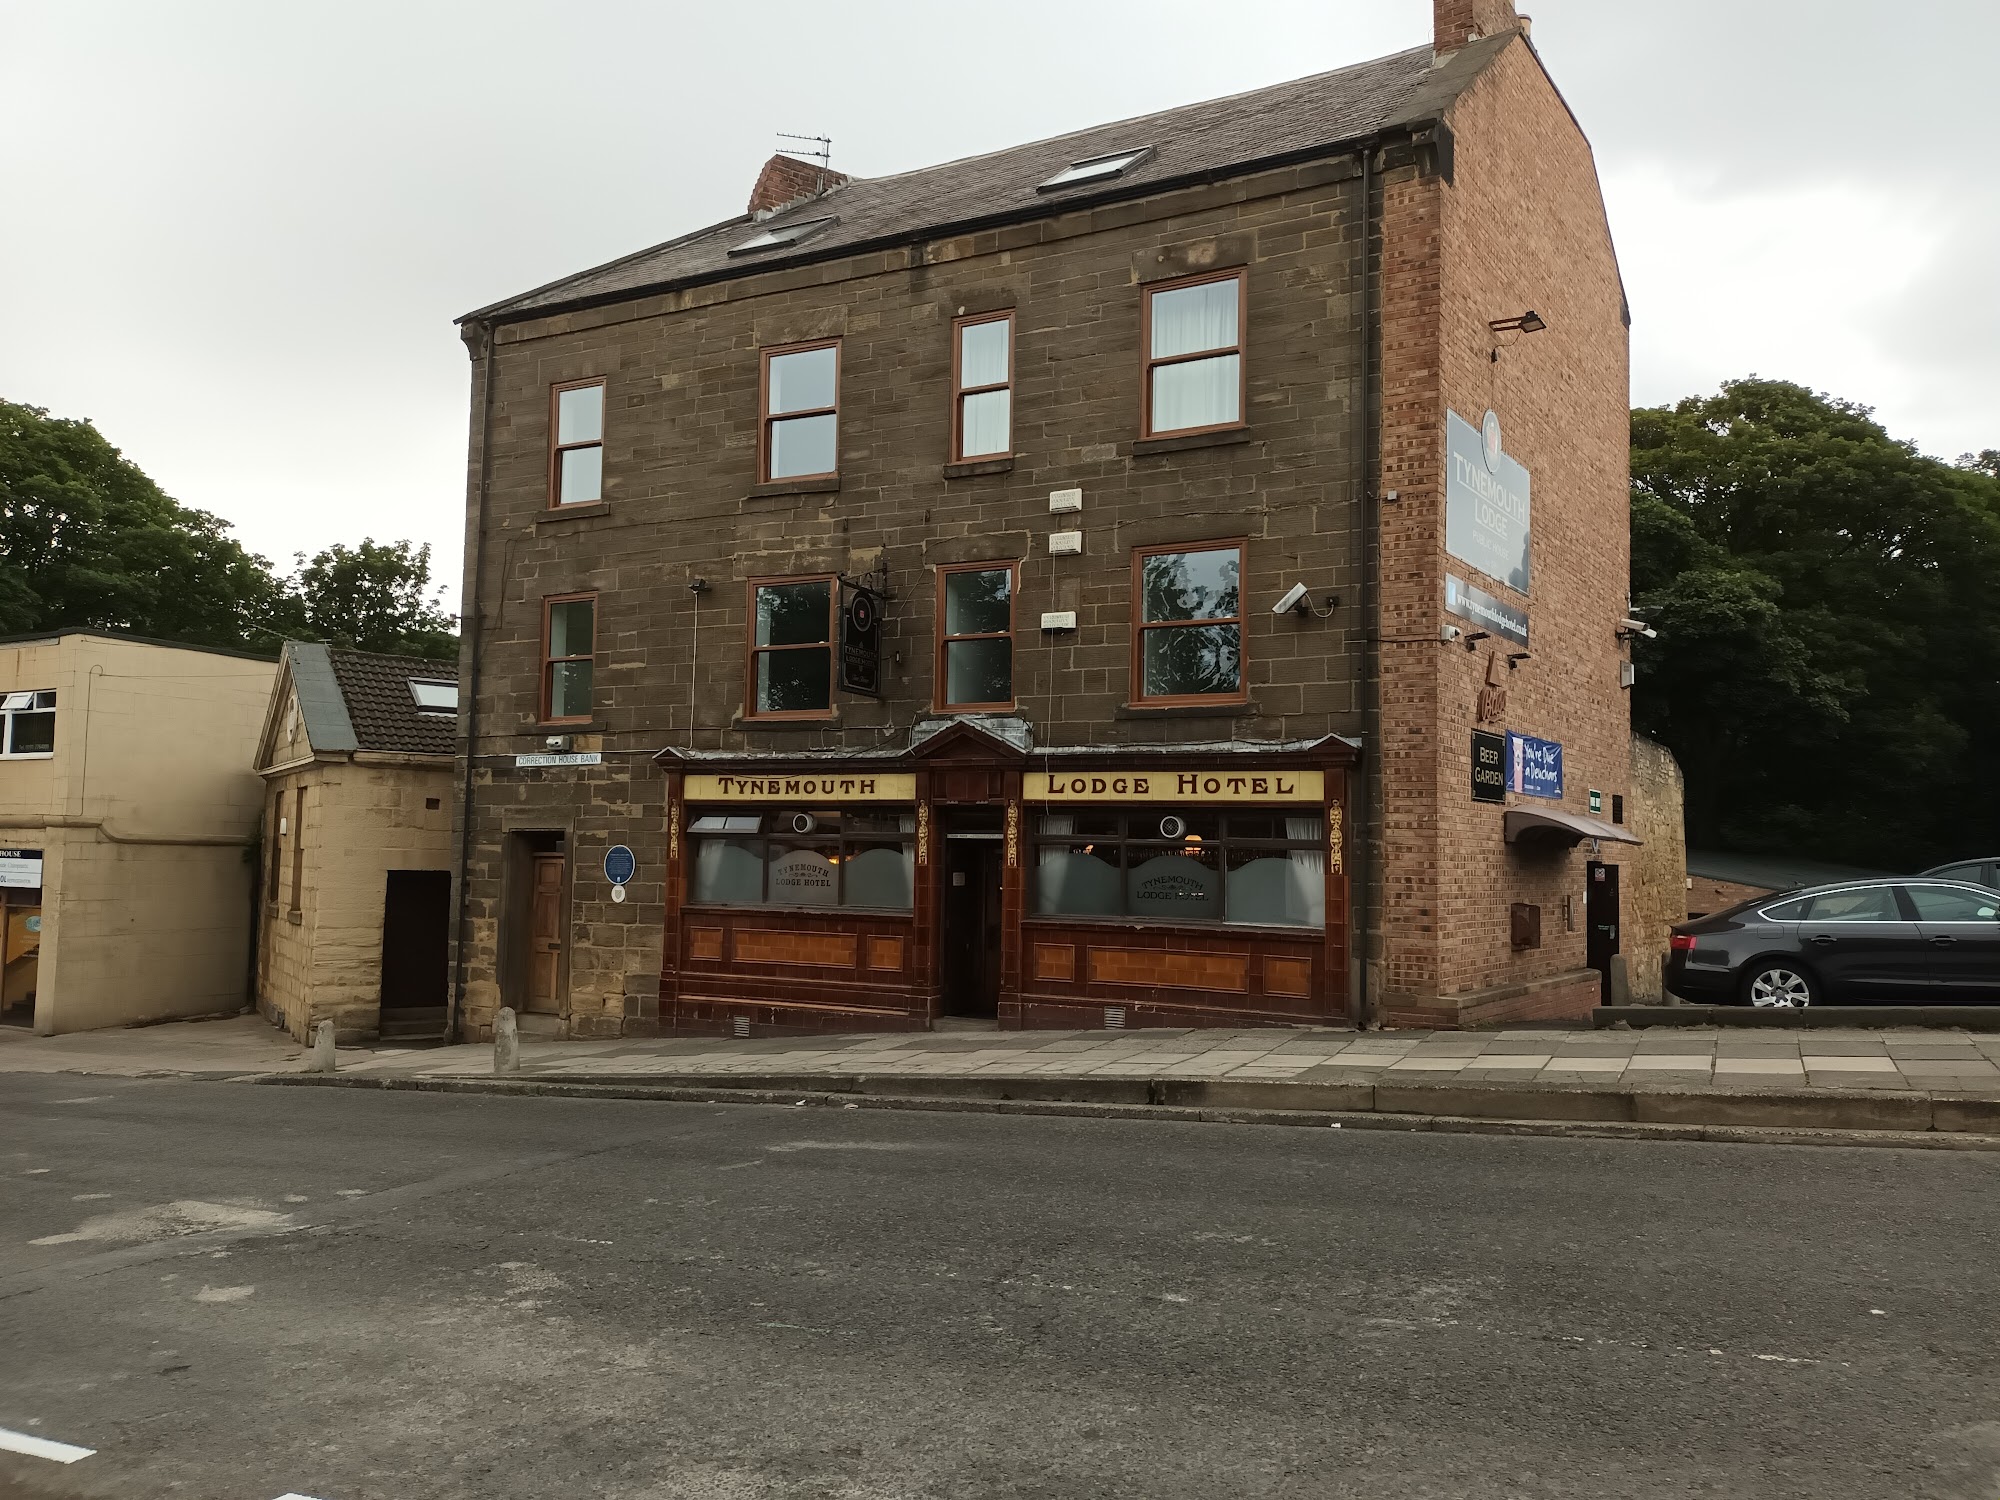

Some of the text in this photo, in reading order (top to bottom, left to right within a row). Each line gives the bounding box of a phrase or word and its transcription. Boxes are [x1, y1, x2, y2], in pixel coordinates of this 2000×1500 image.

[1453, 450, 1526, 524] TYNEMOUTH
[1475, 498, 1508, 537] LODGE
[1472, 528, 1509, 561] PUBLIC HOUSE
[518, 753, 599, 765] CORRECTION HOUSE BANK
[1479, 746, 1499, 765] BEER
[1047, 773, 1295, 795] LODGE HOTEL
[1474, 766, 1504, 786] GARDEN
[718, 777, 876, 795] TYNEMOUTH
[777, 863, 829, 878] TYNEMOUTH
[775, 878, 831, 887] LODGE HOTEL
[1141, 875, 1204, 891] TYNEMOUTH
[1137, 890, 1172, 900] LODGE
